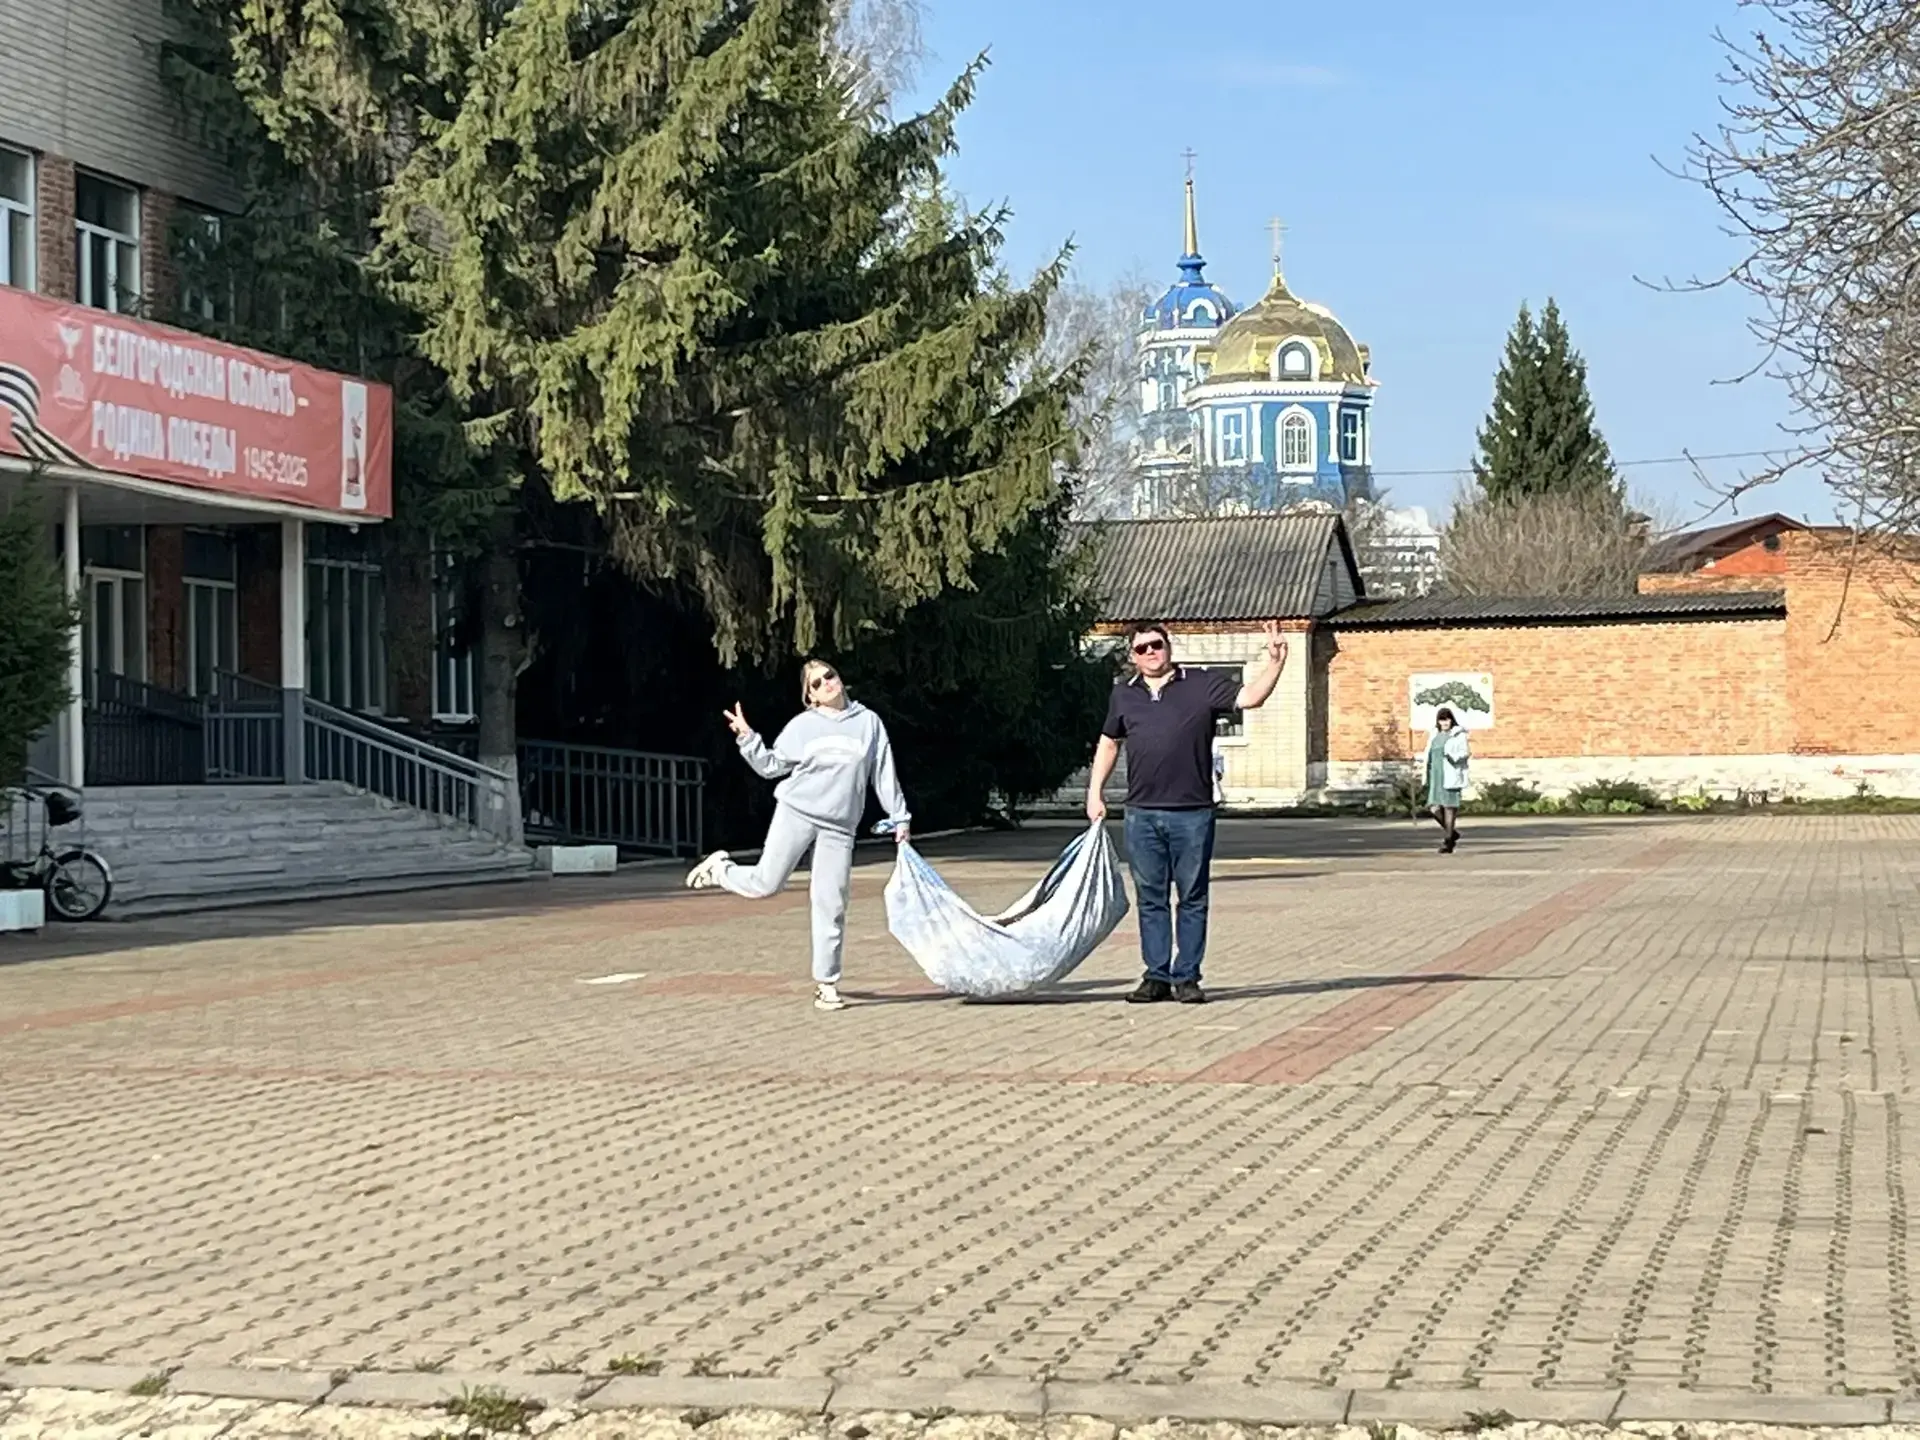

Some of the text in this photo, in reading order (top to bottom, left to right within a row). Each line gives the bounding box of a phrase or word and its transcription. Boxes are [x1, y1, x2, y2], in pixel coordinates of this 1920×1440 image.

[92, 325, 226, 400] БЕЛГОРОДСКАЯ
[228, 358, 295, 417] ОБЛАСТЬ
[91, 400, 308, 487] РОДИНА ПОБЕДЫ 1945-2025
